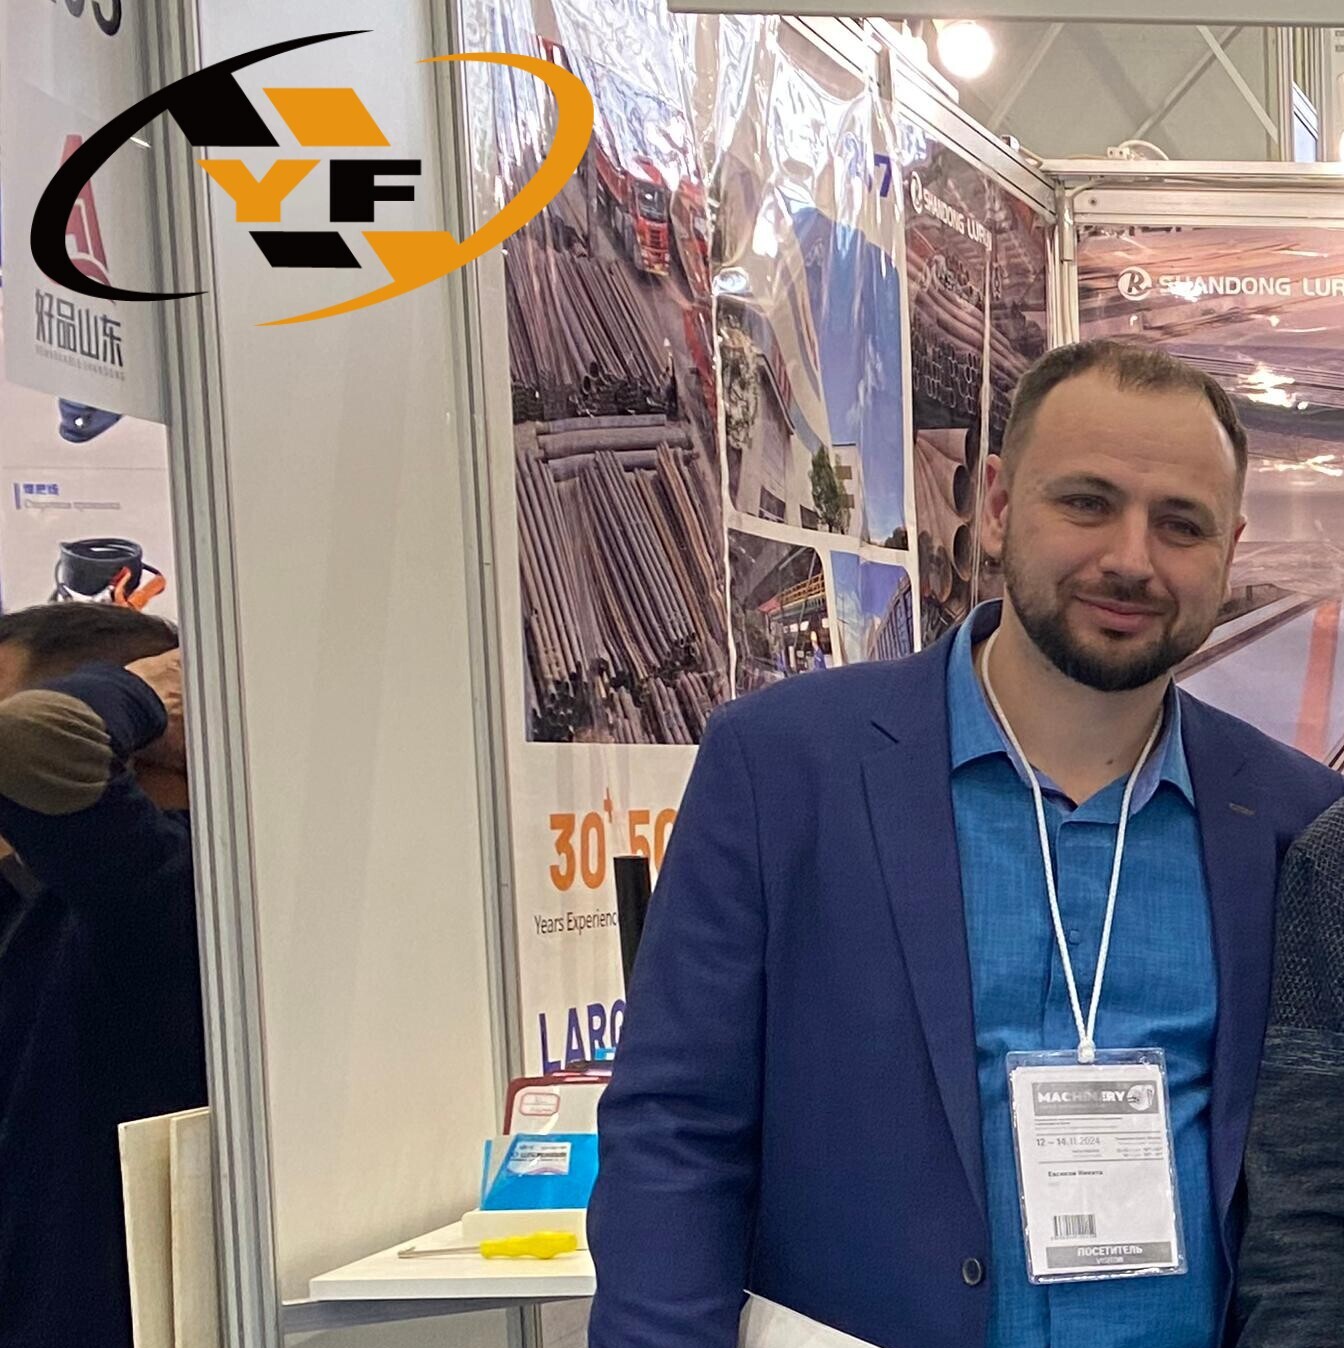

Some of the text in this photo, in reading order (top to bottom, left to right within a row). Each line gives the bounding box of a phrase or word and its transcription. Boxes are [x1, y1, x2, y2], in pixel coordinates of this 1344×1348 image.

[35, 288, 124, 367] 好品山东
[534, 915, 565, 935] Years
[1036, 1138, 1046, 1147] 12
[1077, 1245, 1143, 1258] ПОСЕТИТЕЛЬ
